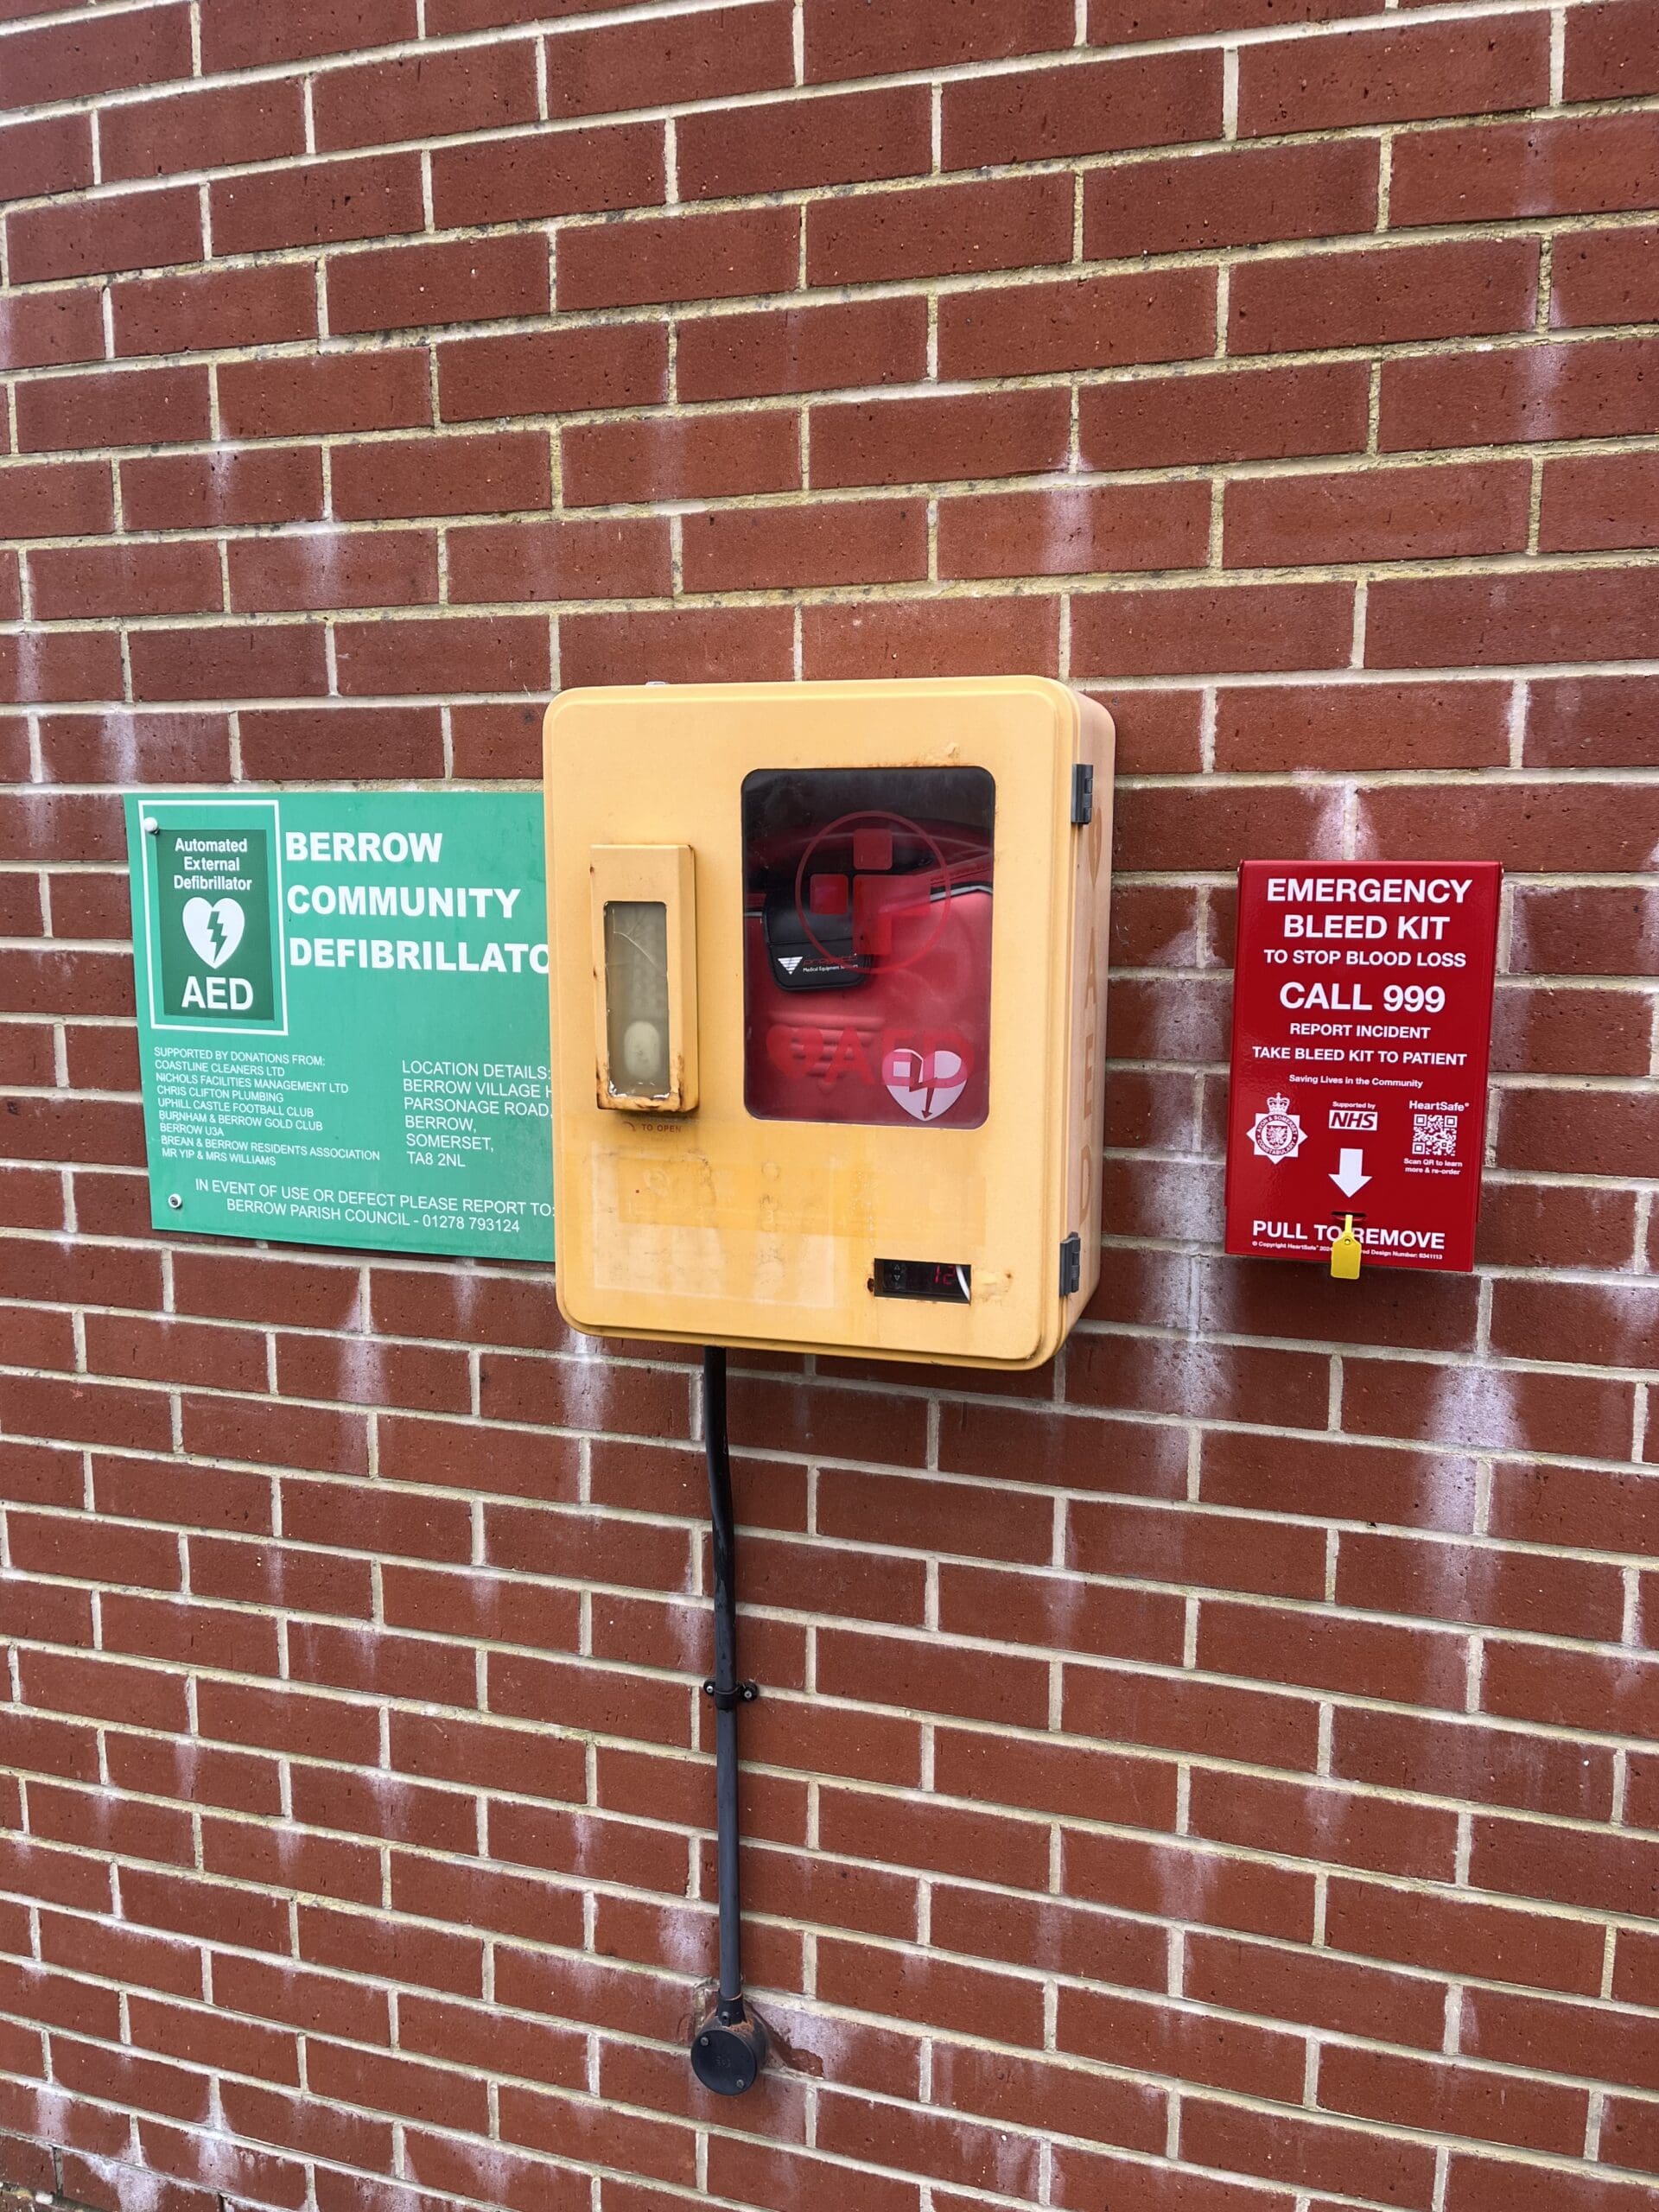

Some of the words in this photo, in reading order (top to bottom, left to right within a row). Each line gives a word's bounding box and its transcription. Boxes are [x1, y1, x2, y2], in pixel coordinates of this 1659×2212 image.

[175, 837, 247, 852] Automated
[286, 832, 442, 861] BERROW
[184, 856, 239, 871] External
[174, 874, 251, 890] Defibrillator
[1268, 878, 1472, 903] EMERGENCY
[287, 885, 520, 918] COMMUNITY
[1284, 914, 1387, 938] BLEED
[1397, 916, 1450, 939] KIT
[1263, 950, 1287, 963] TO
[1293, 950, 1340, 964] STOP
[1346, 950, 1411, 965] BLOOD
[1417, 952, 1465, 967] LOSS
[181, 976, 253, 1010] AED
[1280, 982, 1372, 1010] CALL
[1383, 985, 1445, 1013] 999
[1290, 1023, 1352, 1036] REPORT
[1357, 1025, 1431, 1039] INCIDENT
[154, 1047, 213, 1059] SUPPORTED
[215, 1051, 228, 1059] BY
[231, 1051, 289, 1064] DONATIONS
[292, 1054, 325, 1065] FROM:
[1252, 1046, 1290, 1058] TAKE
[1294, 1048, 1344, 1060] BLEED
[1349, 1050, 1374, 1061] KIT
[1377, 1051, 1398, 1063] TO
[1403, 1052, 1467, 1065] PATIENT
[155, 1059, 208, 1071] COASTLINE
[211, 1063, 264, 1075] CLEANERS
[266, 1066, 284, 1077] LTD
[403, 1060, 478, 1076] LOCATION
[156, 1072, 198, 1084] NICHOLS
[200, 1075, 251, 1087] FACILITIES
[254, 1078, 327, 1091] MANAGEMENT
[329, 1083, 348, 1093] LTD
[404, 1078, 471, 1094] BERROW
[475, 1082, 540, 1097] VILLAGE
[1289, 1074, 1318, 1084] Saving
[1371, 1077, 1423, 1089] Community
[157, 1085, 187, 1096] CHRIS
[188, 1087, 229, 1098] CLIFTON
[232, 1090, 283, 1103] PLUMBING
[158, 1097, 191, 1109] UPHILL
[193, 1100, 230, 1111] CASTLE
[232, 1103, 284, 1116] FOOTBALL
[286, 1106, 314, 1117] CLUB
[404, 1096, 499, 1114] PARSONAGE
[159, 1110, 207, 1122] BURNHAM
[209, 1114, 216, 1122] &
[218, 1114, 262, 1126] BERROW
[264, 1117, 293, 1128] GOLD
[296, 1120, 322, 1130] CLUB
[160, 1122, 202, 1134] BERROW
[205, 1126, 224, 1135] U3A
[405, 1115, 476, 1133] BERROW,
[657, 1123, 682, 1133] OPEN
[1256, 1119, 1268, 1133] AVON
[1331, 1112, 1376, 1128] NHS
[161, 1135, 194, 1146] BREAN
[196, 1138, 202, 1147] &
[205, 1138, 248, 1150] BERROW
[251, 1142, 308, 1155] RESIDENTS
[309, 1147, 379, 1160] ASSOCIATION
[406, 1133, 493, 1152] SOMERSET,
[1257, 1139, 1295, 1155] CONSTABULARY
[162, 1147, 177, 1157] MR
[179, 1149, 194, 1158] YIP
[197, 1150, 203, 1160] &
[206, 1151, 227, 1161] MRS
[229, 1154, 276, 1166] WILLIAMS
[408, 1151, 433, 1165] TA8
[437, 1153, 465, 1166] 2NL
[195, 1179, 208, 1191] IN
[212, 1179, 255, 1195] EVENT
[259, 1184, 276, 1197] OF
[282, 1186, 309, 1200] USE
[313, 1189, 334, 1202] OR
[338, 1191, 395, 1206] DEFECT
[400, 1195, 457, 1211] PLEASE
[462, 1198, 526, 1214] REPORT
[226, 1198, 286, 1215] BERROW
[290, 1204, 340, 1220] PARISH
[345, 1208, 410, 1225] COUNCIL
[423, 1214, 464, 1229] 01278
[469, 1217, 519, 1232] 793124
[1253, 1220, 1307, 1239] PULL
[1313, 1224, 1343, 1242] TO
[1353, 1228, 1445, 1249] REMOVE
